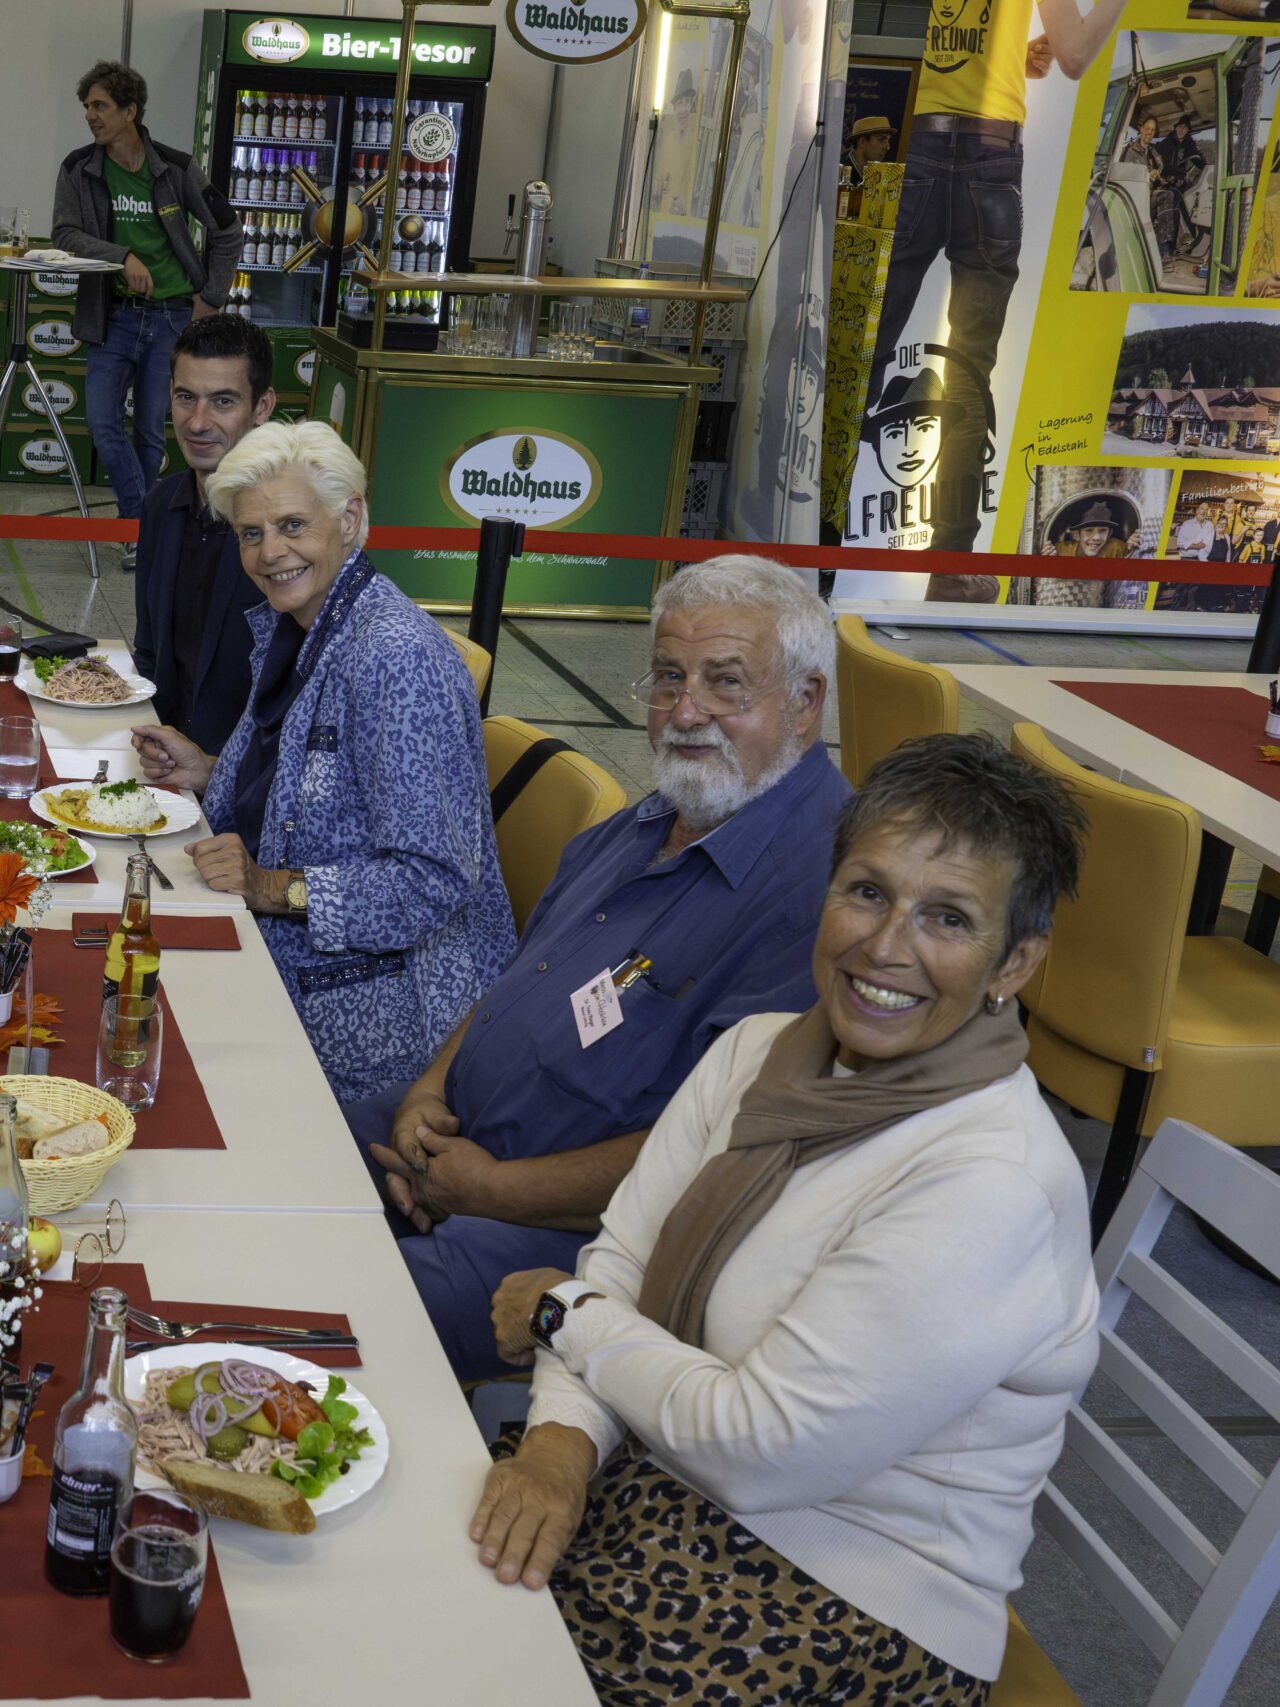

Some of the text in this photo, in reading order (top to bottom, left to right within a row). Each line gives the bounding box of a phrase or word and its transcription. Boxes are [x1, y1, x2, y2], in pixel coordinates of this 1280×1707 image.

[524, 3, 629, 37] Waldhaus
[251, 35, 301, 53] Waldhaus
[415, 116, 447, 132] Garantiert
[412, 138, 446, 159] Naturhopfen
[34, 334, 75, 346] Waldhaus
[899, 342, 922, 370] DIE
[1039, 412, 1093, 429] Lagerung
[1038, 431, 1052, 443] in
[1038, 438, 1089, 456] Edelstahl
[461, 468, 582, 504] Waldhaus
[1180, 481, 1265, 503] Familienbetrieb
[887, 530, 928, 550] SEIT 2019
[526, 552, 545, 565] dem
